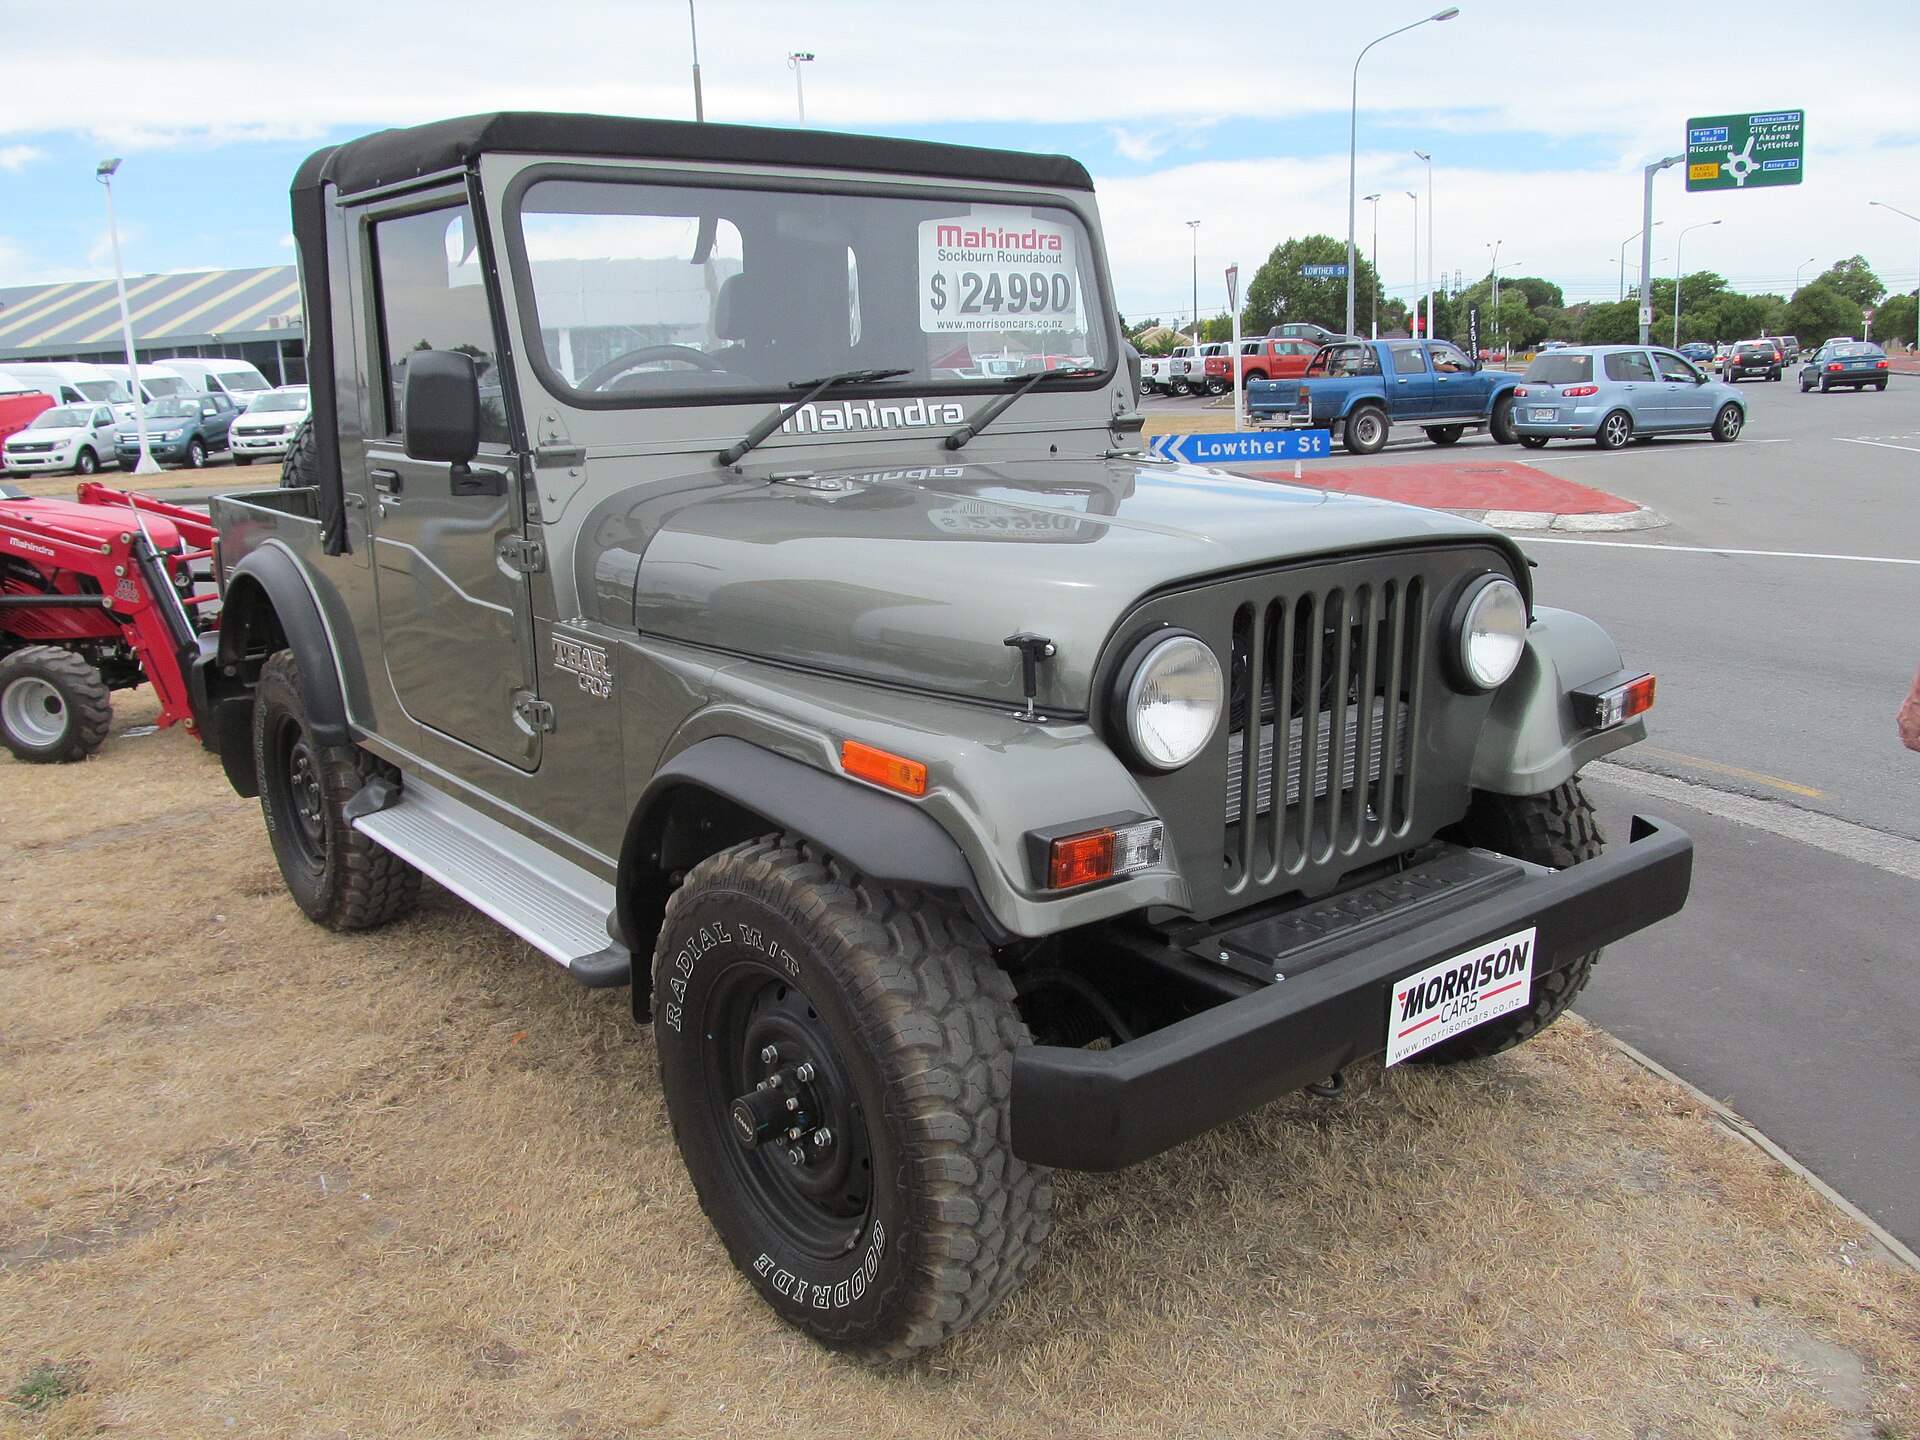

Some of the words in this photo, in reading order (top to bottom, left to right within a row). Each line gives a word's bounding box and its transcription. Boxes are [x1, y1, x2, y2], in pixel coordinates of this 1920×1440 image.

[1750, 126, 1768, 134] City
[1772, 124, 1799, 132] Centre
[1758, 133, 1791, 141] Akaroa
[1690, 144, 1733, 153] Riccarton
[1756, 141, 1799, 151] Lyttelton
[937, 225, 1062, 250] Mahindra
[938, 249, 994, 262] Sockburn
[997, 250, 1063, 264] Roundabout
[1304, 266, 1334, 275] LOWTHER
[1337, 266, 1346, 275] ST
[960, 271, 1071, 314] 24990
[937, 318, 1063, 329] www.morrisoncars.co.nz
[779, 399, 964, 433] Mahindra
[1197, 437, 1286, 457] Lowther
[1298, 436, 1321, 453] St
[10, 537, 54, 556] Mahindra
[666, 922, 732, 1031] RADIAL
[1401, 940, 1530, 1022] MORRISON
[1441, 991, 1479, 1023] CARS
[1394, 997, 1520, 1059] www.morrisoncars.co.nz
[753, 1220, 885, 1309] GOODRIDE
